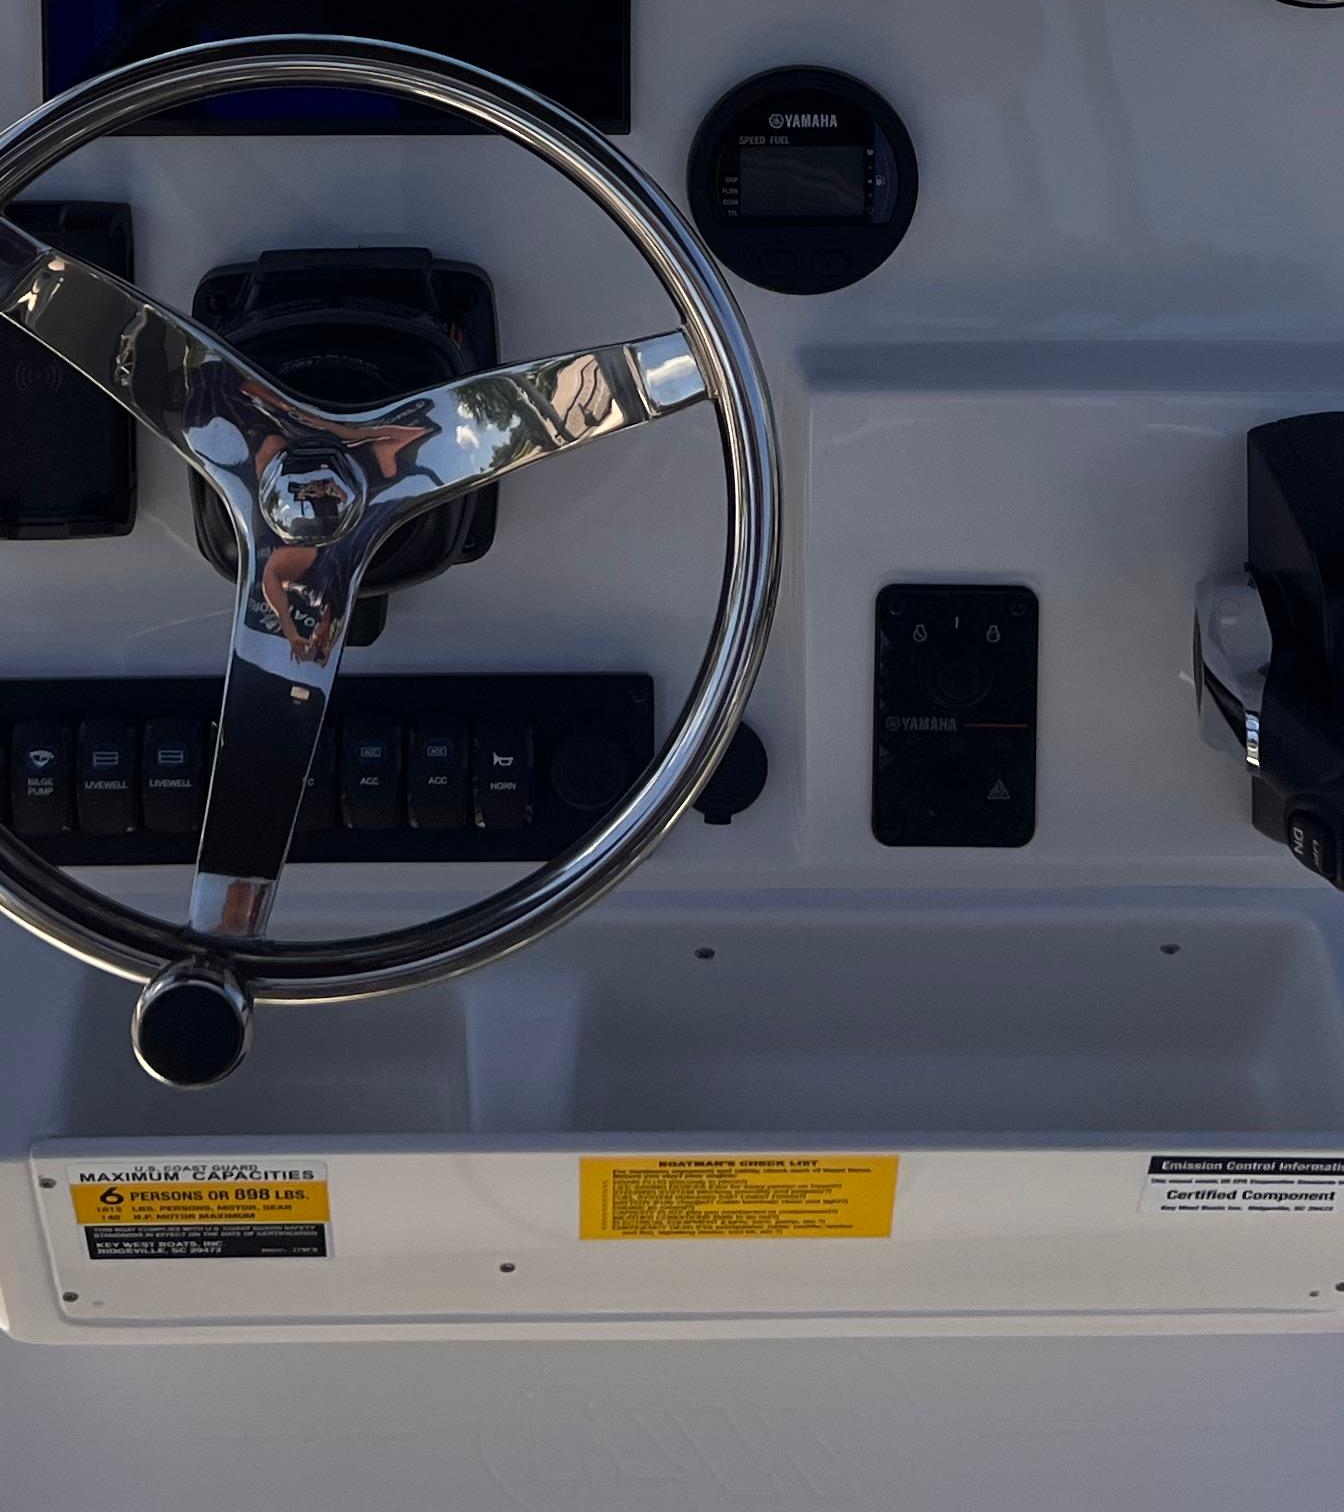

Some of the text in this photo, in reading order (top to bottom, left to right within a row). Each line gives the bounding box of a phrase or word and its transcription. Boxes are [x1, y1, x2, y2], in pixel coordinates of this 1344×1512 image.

[784, 112, 839, 129] YAMAHA
[738, 135, 791, 145] SPEED FUEL
[901, 716, 959, 732] YAMAHA
[84, 779, 129, 790] LIVEWELL
[148, 778, 193, 788] LIVEWELL
[359, 775, 380, 786] ACC
[427, 774, 448, 785] ACC
[489, 781, 517, 791] HORN
[1293, 826, 1305, 856] DN
[163, 1164, 208, 1173] COAST
[211, 1164, 259, 1172] GUARD
[1161, 1160, 1223, 1171] Emission
[1226, 1161, 1276, 1172] Control
[79, 1169, 315, 1183] MAXIMUM CAPACITIES
[99, 1186, 310, 1206] 6 PERSONS OR 898 LBS.
[1166, 1189, 1336, 1202] Certified Component
